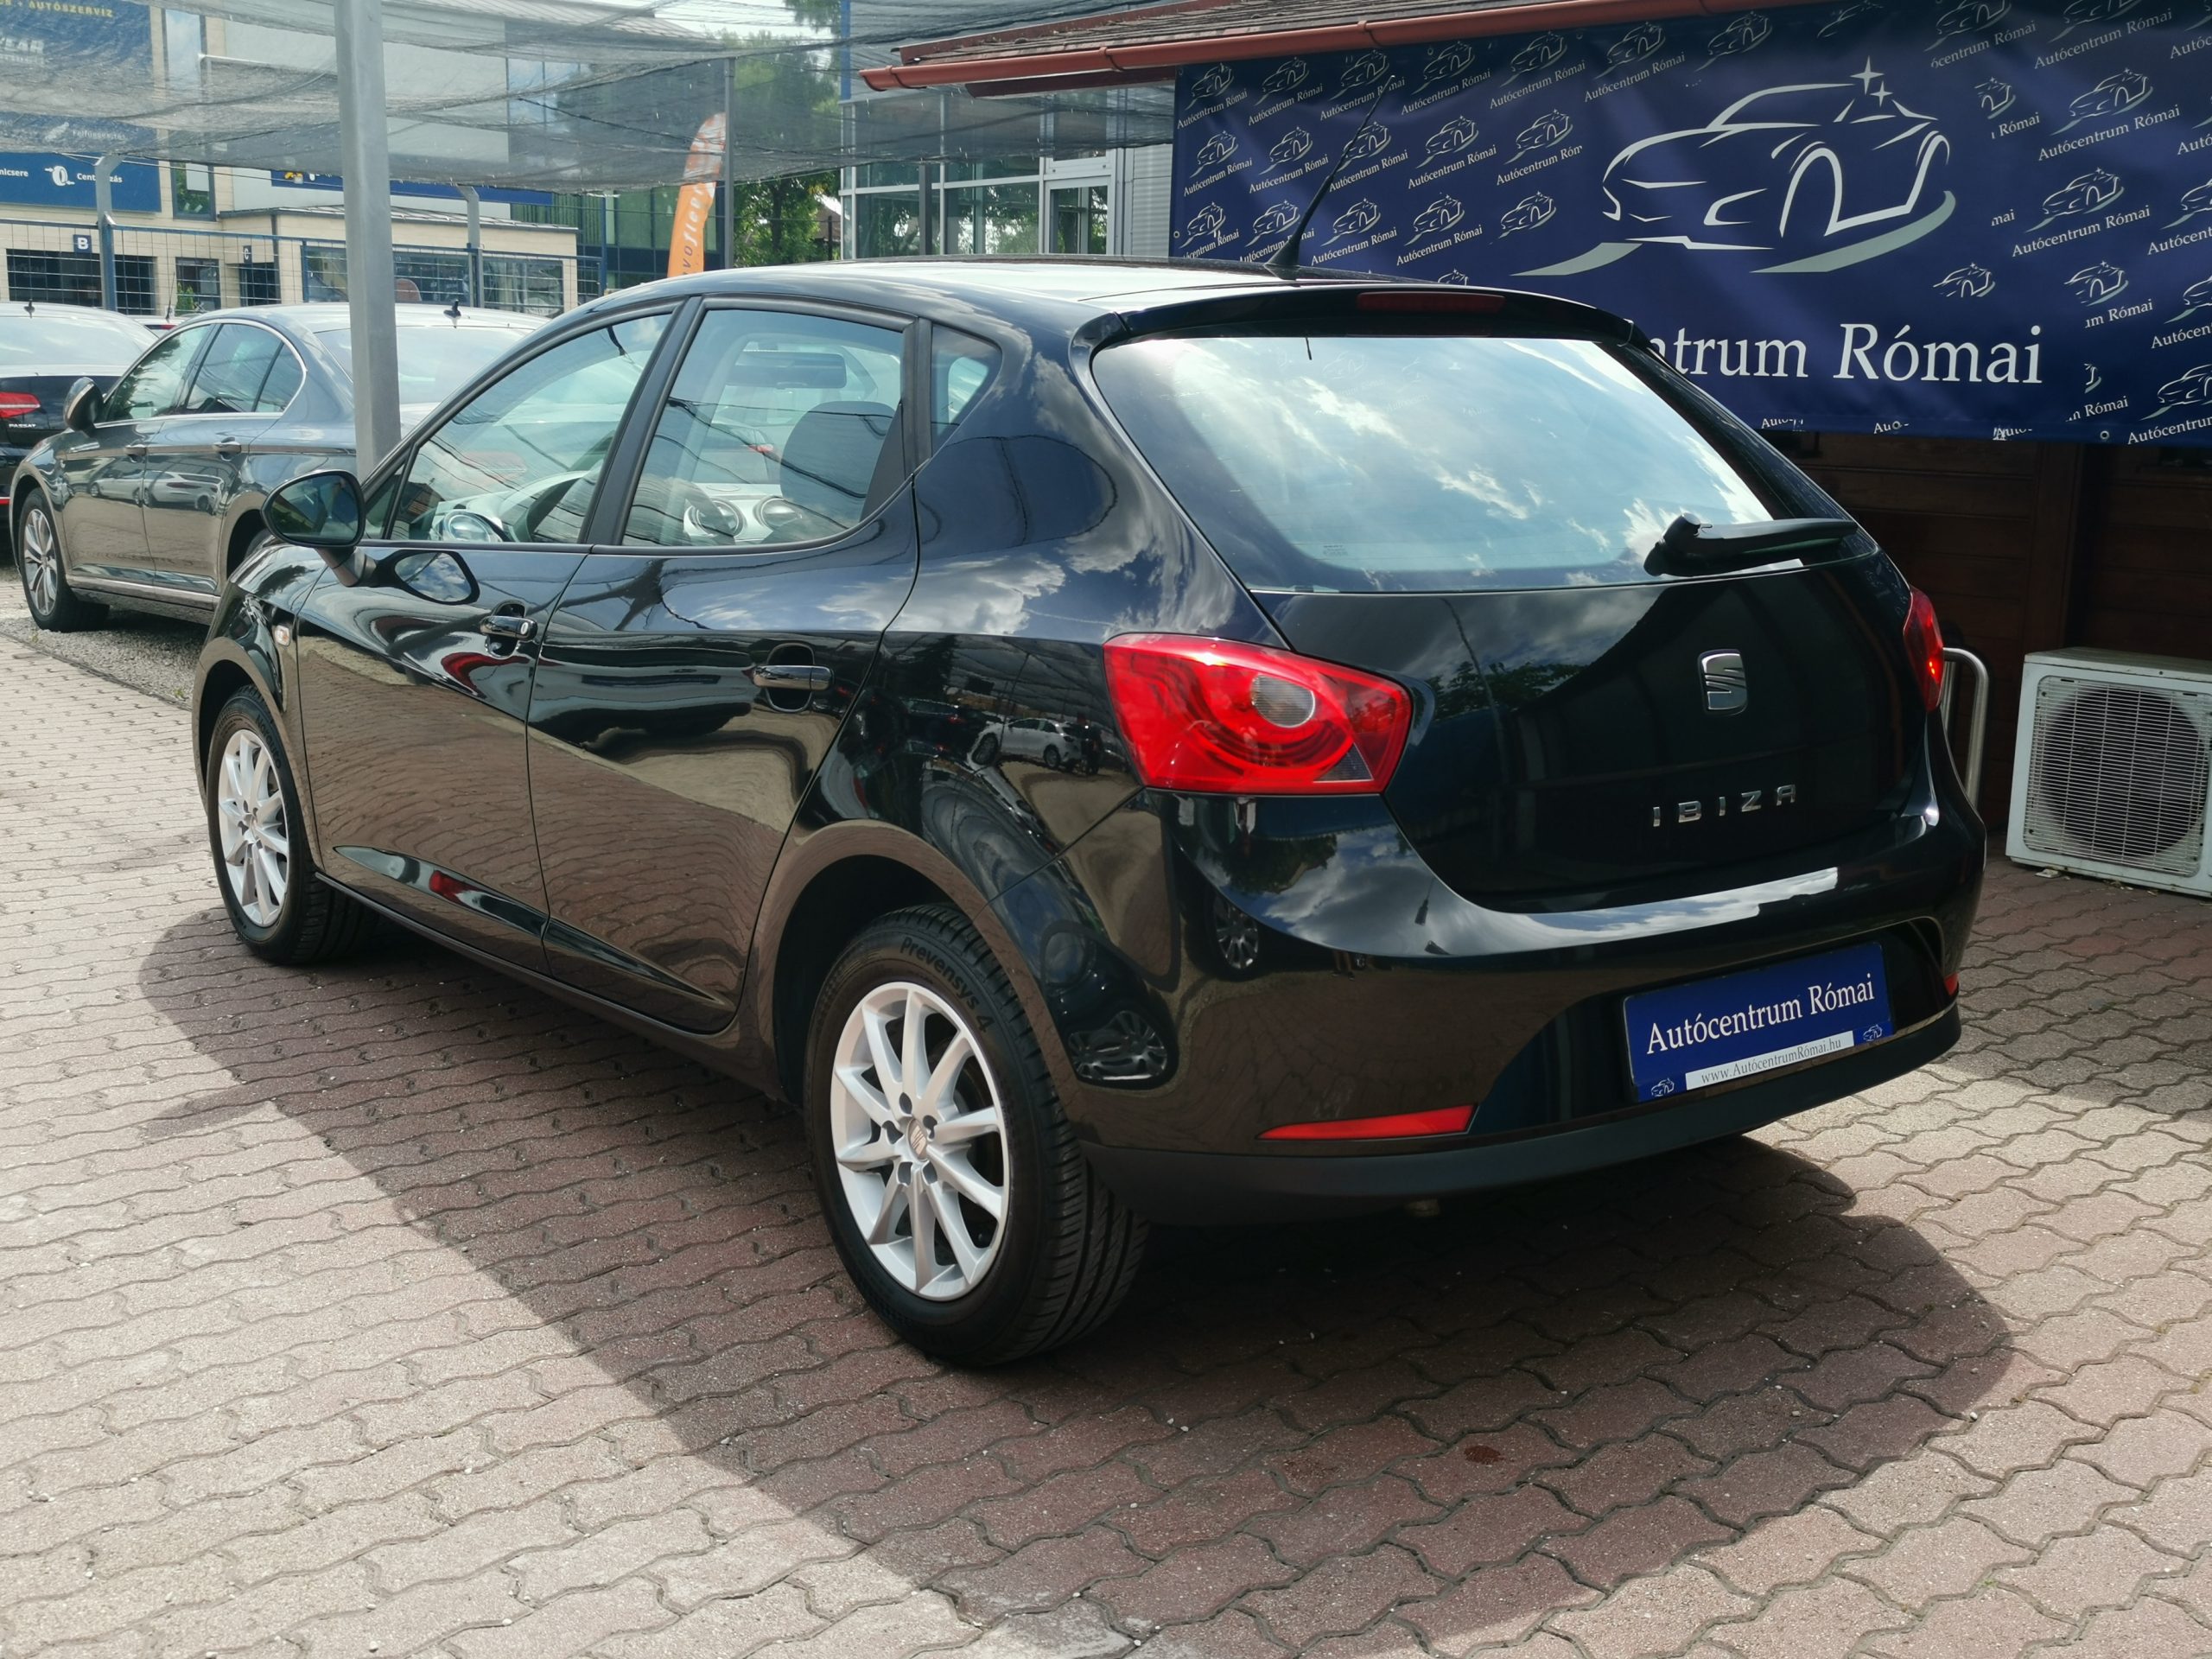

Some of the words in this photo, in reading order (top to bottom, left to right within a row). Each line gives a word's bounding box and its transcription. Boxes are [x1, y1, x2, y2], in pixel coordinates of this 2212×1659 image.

[1994, 21, 2037, 45] Római
[2034, 29, 2123, 70] Autócentrum
[2126, 8, 2172, 35] Római
[1401, 82, 1459, 116] Autócentrum
[1461, 68, 1491, 89] Római
[1489, 77, 1553, 110] Autócentrum
[1554, 59, 1586, 83] Római
[1584, 70, 1650, 103] Autócentrum
[1652, 51, 1686, 75] Római
[1176, 101, 1224, 130] Autócentrum
[1225, 90, 1248, 107] Római
[1248, 98, 1295, 126] Autócentrum
[1296, 84, 1323, 101] Római
[1319, 91, 1376, 121] Autócentrum
[1376, 77, 1405, 96] Rmai
[1999, 111, 2041, 137] Római
[2037, 124, 2130, 162] Autócentrum
[2133, 104, 2180, 131] Római
[1183, 168, 1227, 197] Autócentrum
[1227, 157, 1253, 175] Római
[1249, 164, 1304, 194] Autócentrum
[1304, 153, 1329, 173] Római
[1328, 162, 1381, 193] Autócentrum
[1381, 149, 1408, 169] Római
[1408, 157, 1466, 190] Autócentrum
[1467, 144, 1497, 166] Római
[1496, 154, 1558, 186] Autócentrum
[78, 237, 89, 250] B
[1183, 239, 1217, 258] ócentrum
[1217, 228, 1240, 246] Római
[1239, 238, 1286, 263] Autócentrum
[1311, 235, 1370, 266] Autócentrum
[1370, 226, 1398, 249] Római
[1396, 235, 1453, 266] Autócentrum
[1453, 224, 1484, 244] Római
[2012, 223, 2101, 257] Autócentrum
[2105, 204, 2151, 230] Római
[2107, 298, 2153, 322] Római
[1833, 323, 2043, 384] Római
[2151, 322, 2212, 349] Autócen
[2084, 395, 2129, 418] Római
[1652, 784, 1796, 827] IBIZA
[899, 937, 980, 1010] Prevensys
[976, 1015, 996, 1033] 4
[1646, 998, 1803, 1055] Autócentrum
[1808, 973, 1875, 1015] Római
[1700, 1038, 1842, 1084] www.AutócentrumRómai.hu
